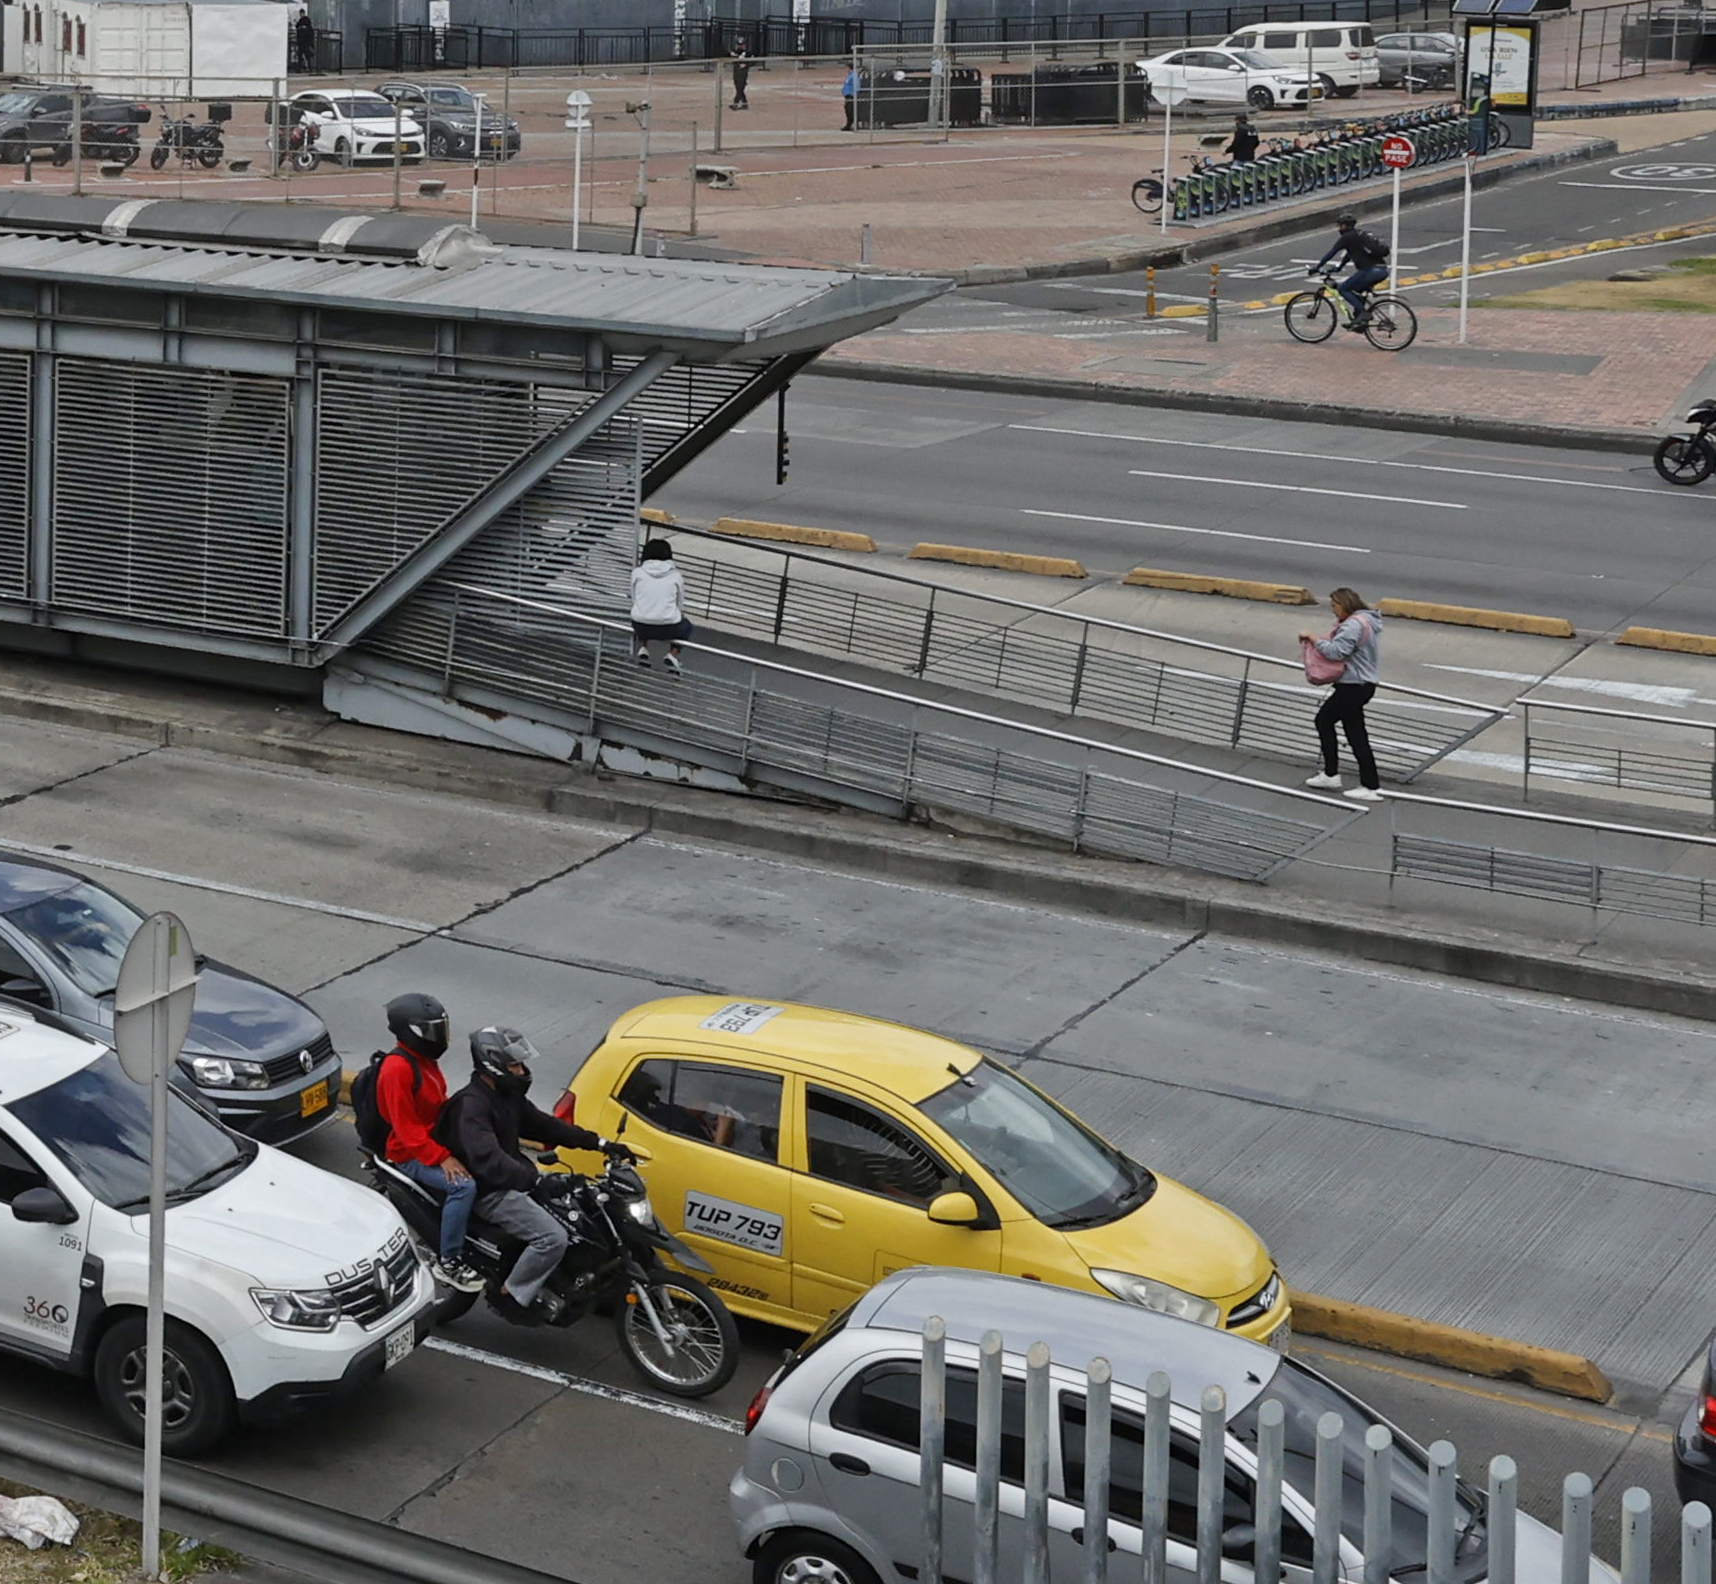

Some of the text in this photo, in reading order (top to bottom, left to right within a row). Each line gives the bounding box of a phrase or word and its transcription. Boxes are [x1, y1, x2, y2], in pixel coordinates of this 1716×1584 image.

[1391, 142, 1403, 150] NO
[1385, 154, 1407, 163] PASE
[687, 1201, 781, 1241] TUP 793
[59, 1236, 82, 1251] 1091
